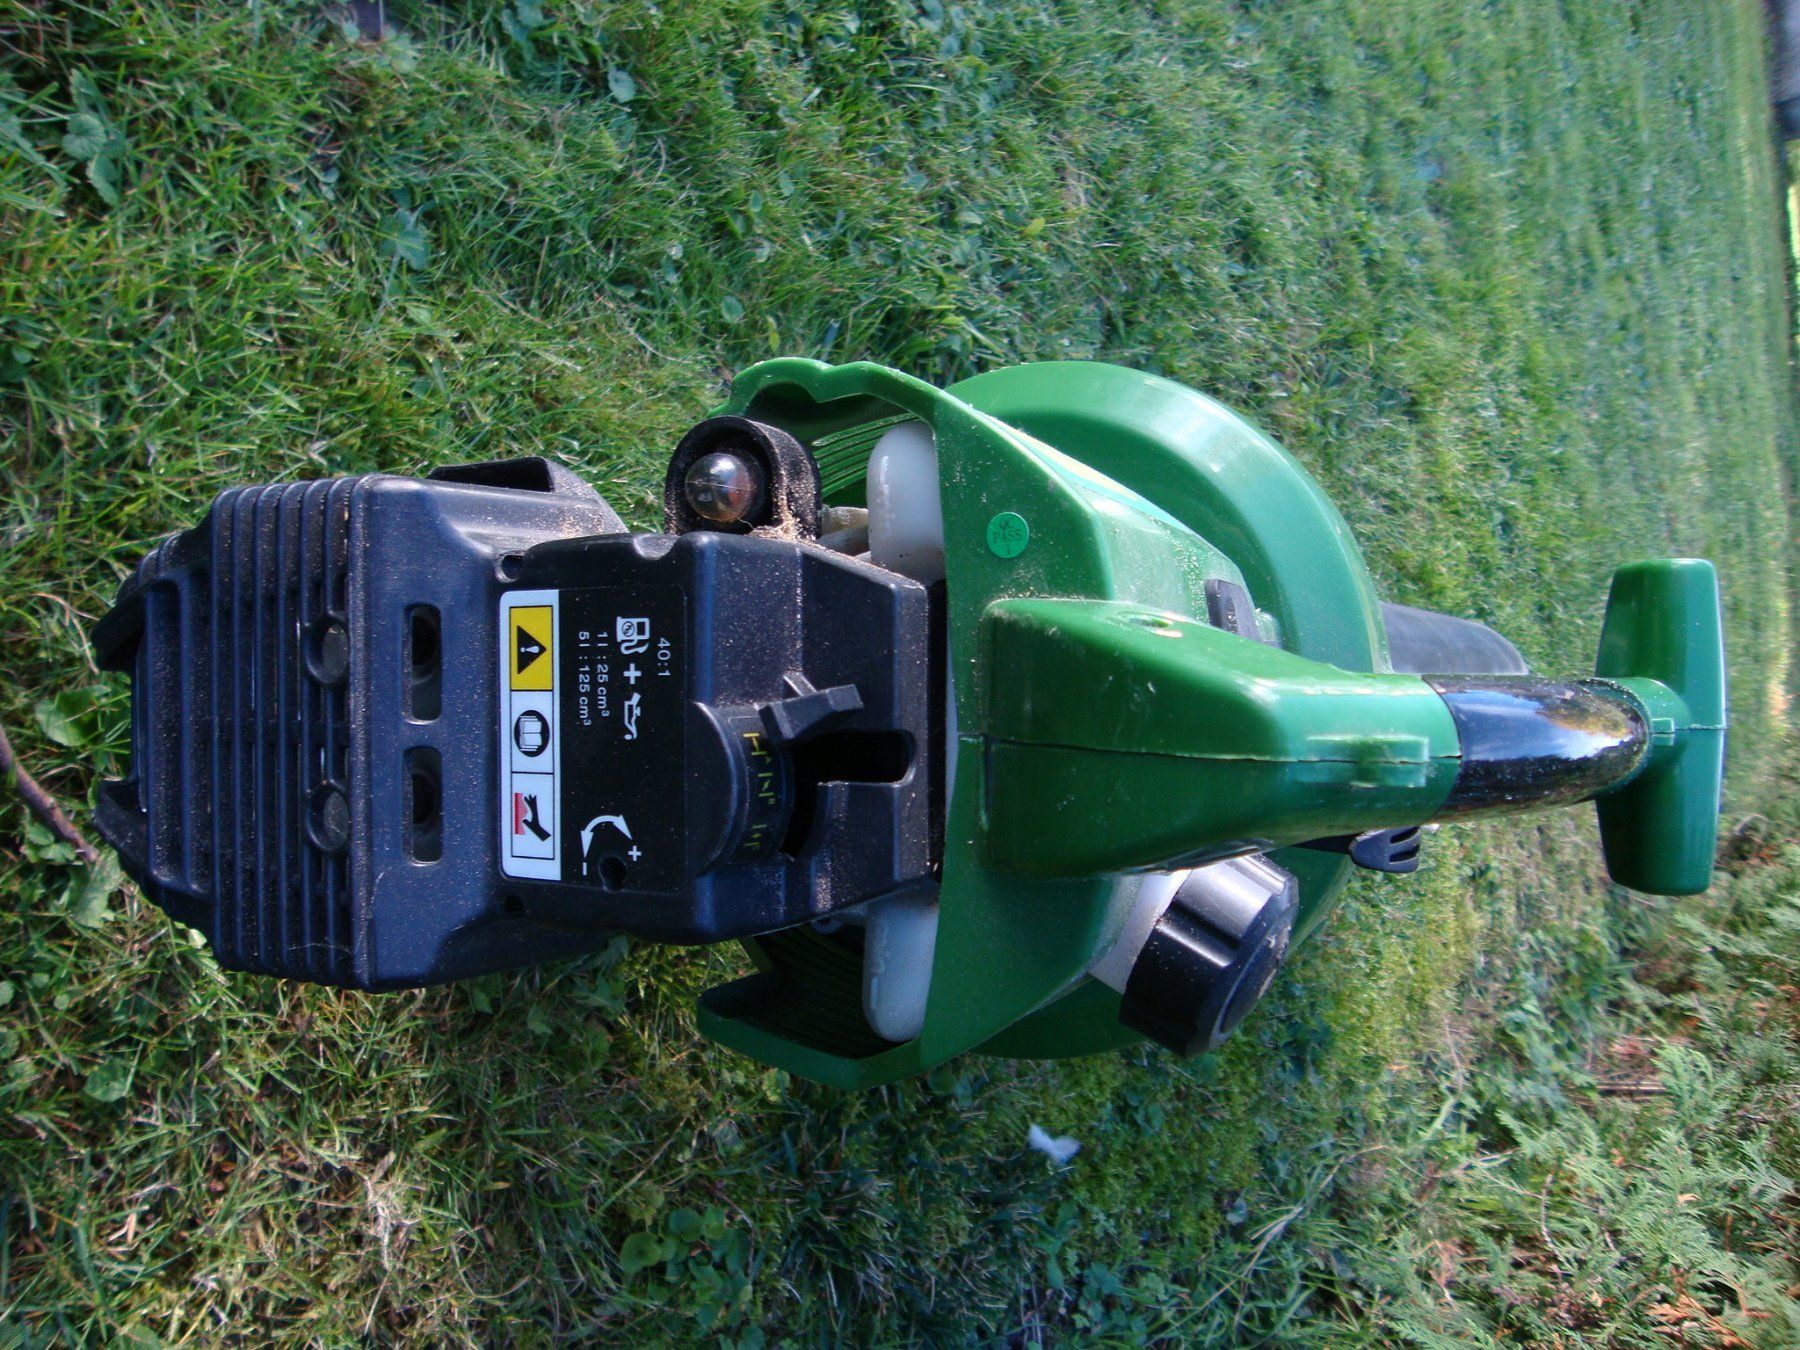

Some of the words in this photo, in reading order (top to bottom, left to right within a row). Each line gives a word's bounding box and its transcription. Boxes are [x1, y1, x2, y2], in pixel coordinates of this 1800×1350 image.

[991, 528, 1022, 544] PASS
[657, 637, 671, 676] 40:1
[579, 665, 590, 693] 125
[597, 664, 609, 683] 25
